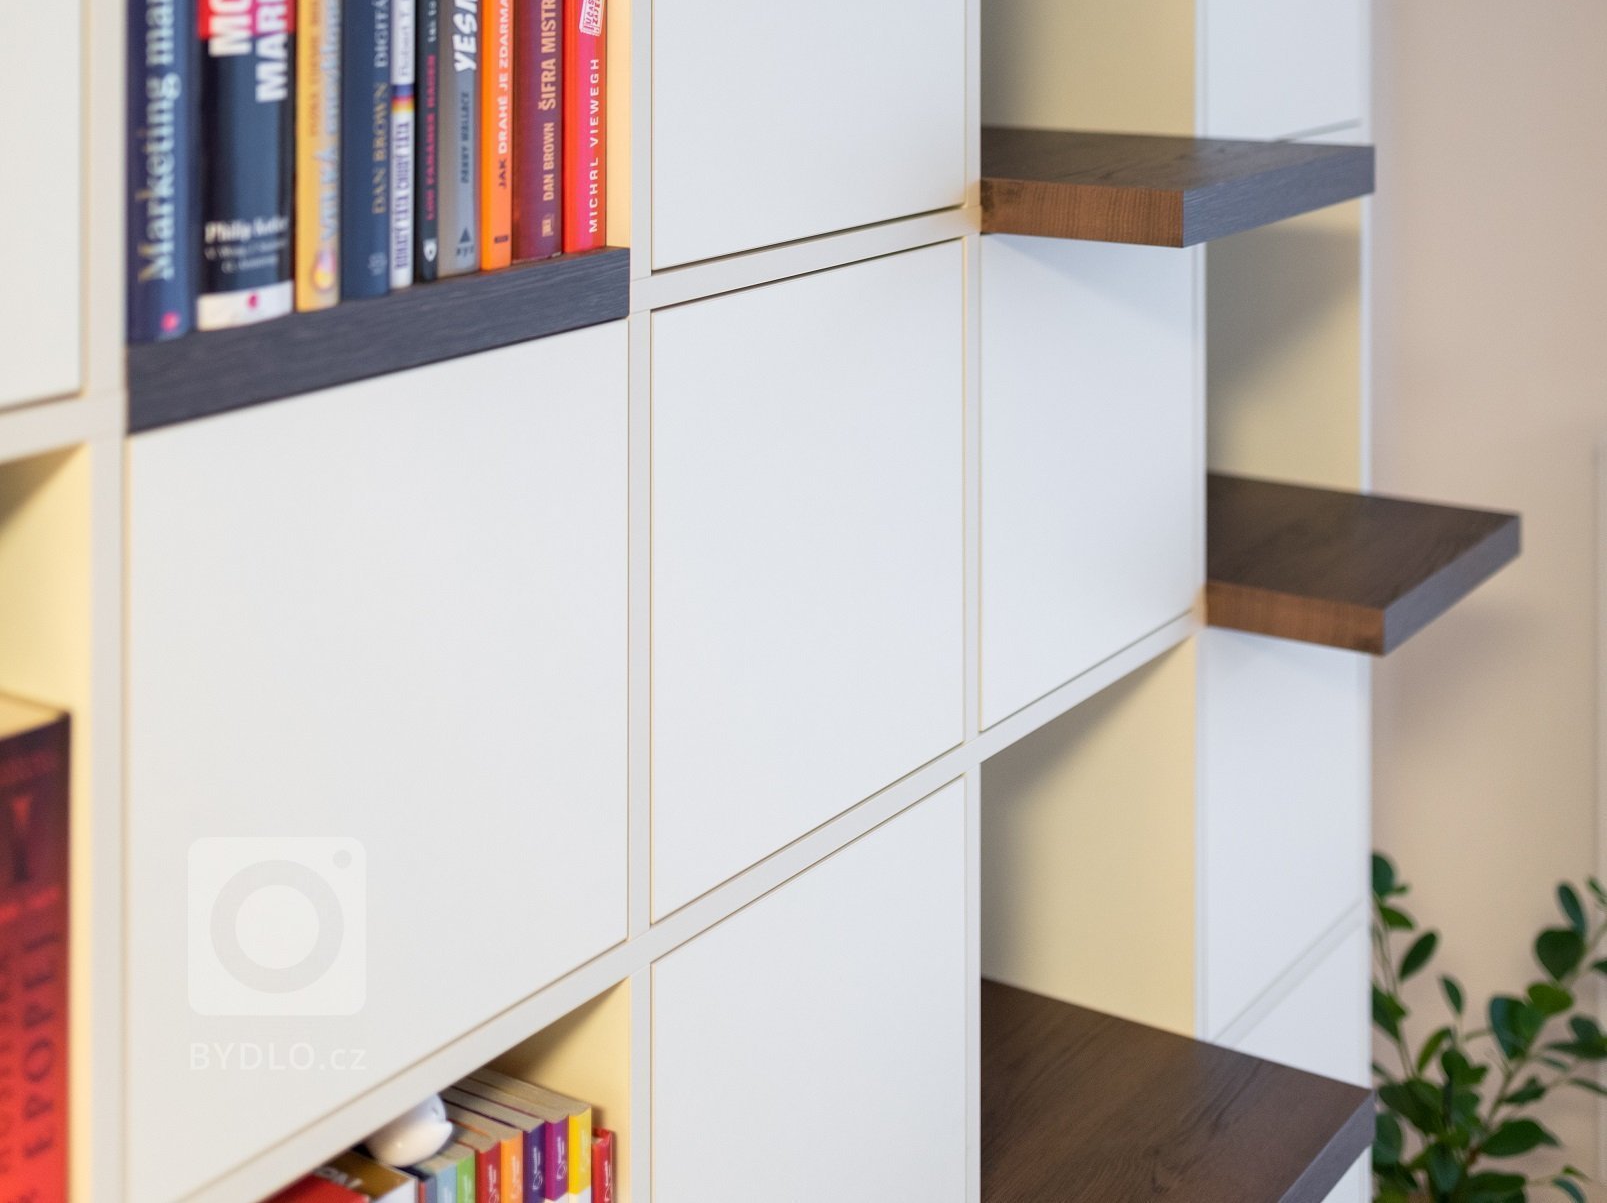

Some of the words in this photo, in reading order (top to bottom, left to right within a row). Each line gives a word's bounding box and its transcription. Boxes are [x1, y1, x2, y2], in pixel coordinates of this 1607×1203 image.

[499, 72, 509, 91] JE
[538, 58, 557, 112] ŠIFRA
[589, 59, 600, 148] VIEWEGH
[372, 82, 388, 162] BROWN
[497, 96, 509, 155] DRAHÉ
[543, 122, 555, 171] BROWN
[136, 70, 182, 283] Marketing
[371, 167, 388, 215] DAN
[498, 158, 508, 190] JAK
[543, 173, 554, 202] DAN
[588, 157, 600, 234] MICHAL
